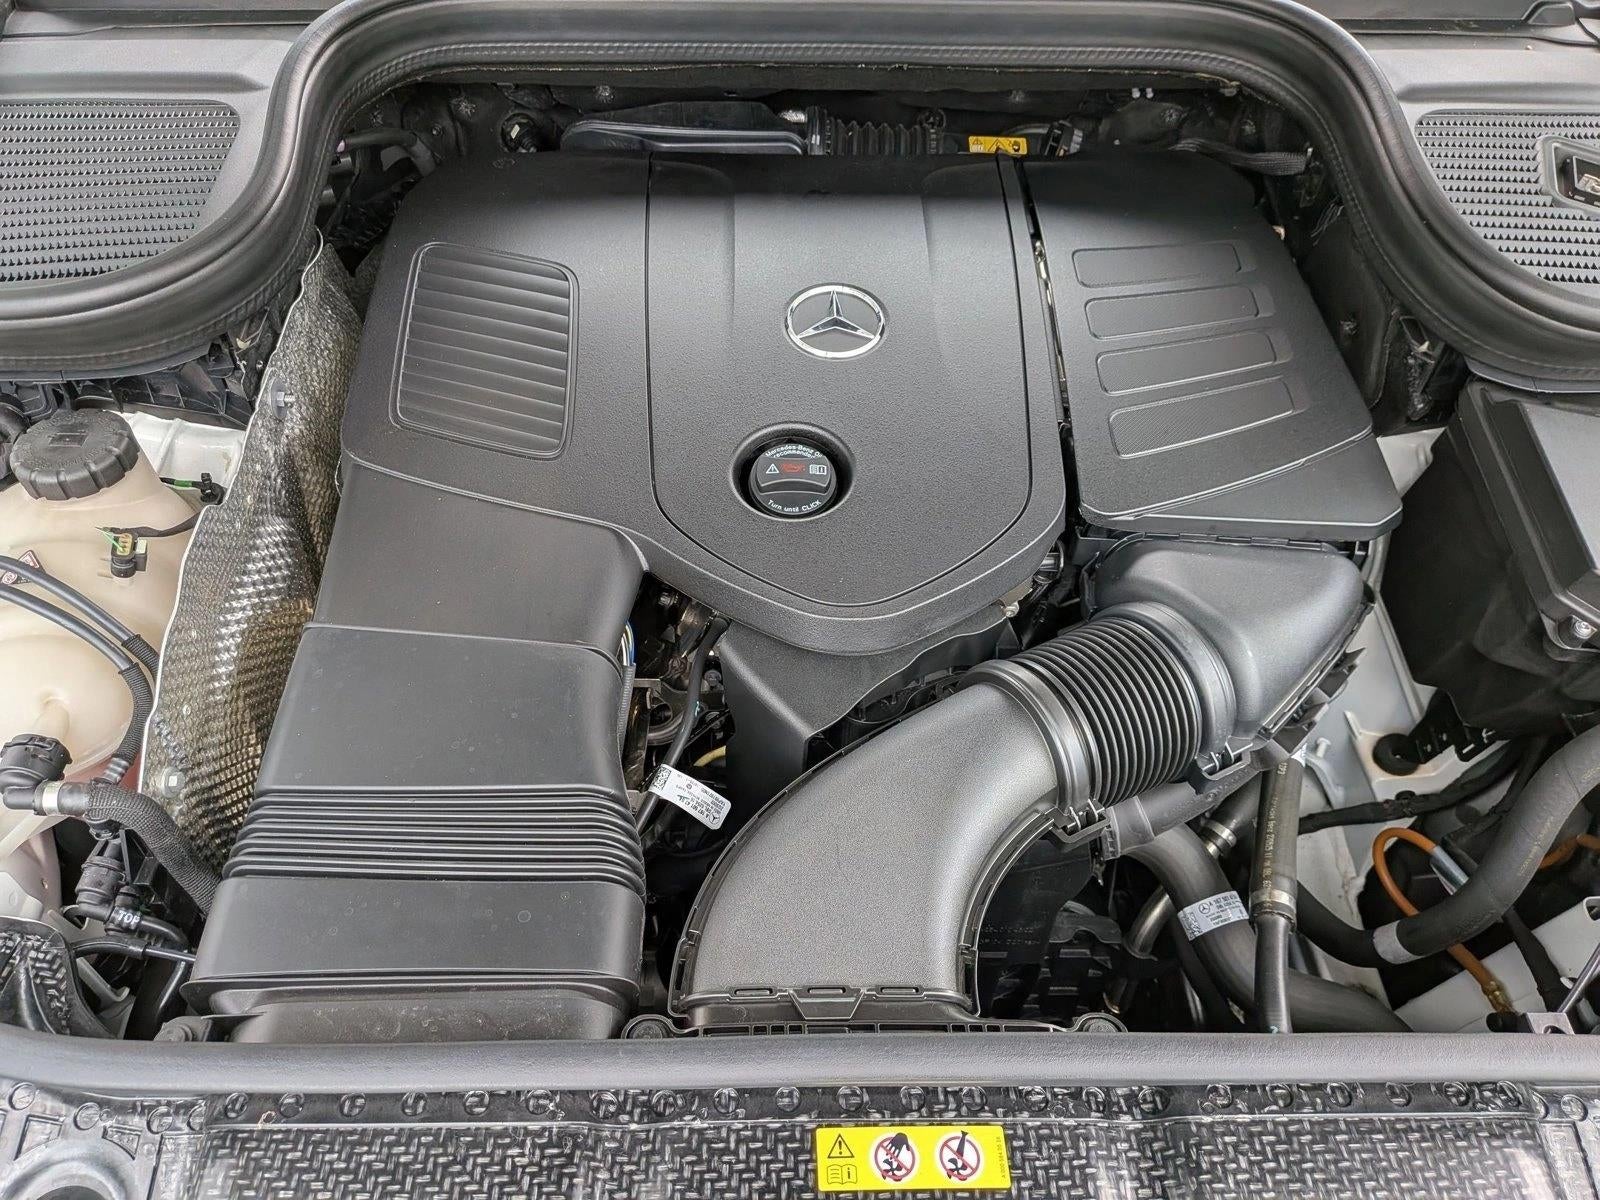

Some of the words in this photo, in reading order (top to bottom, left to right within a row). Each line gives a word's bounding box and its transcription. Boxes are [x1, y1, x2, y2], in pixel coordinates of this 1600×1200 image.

[767, 499, 782, 510] Turn
[801, 499, 822, 511] CLICK
[118, 910, 140, 924] TOP
